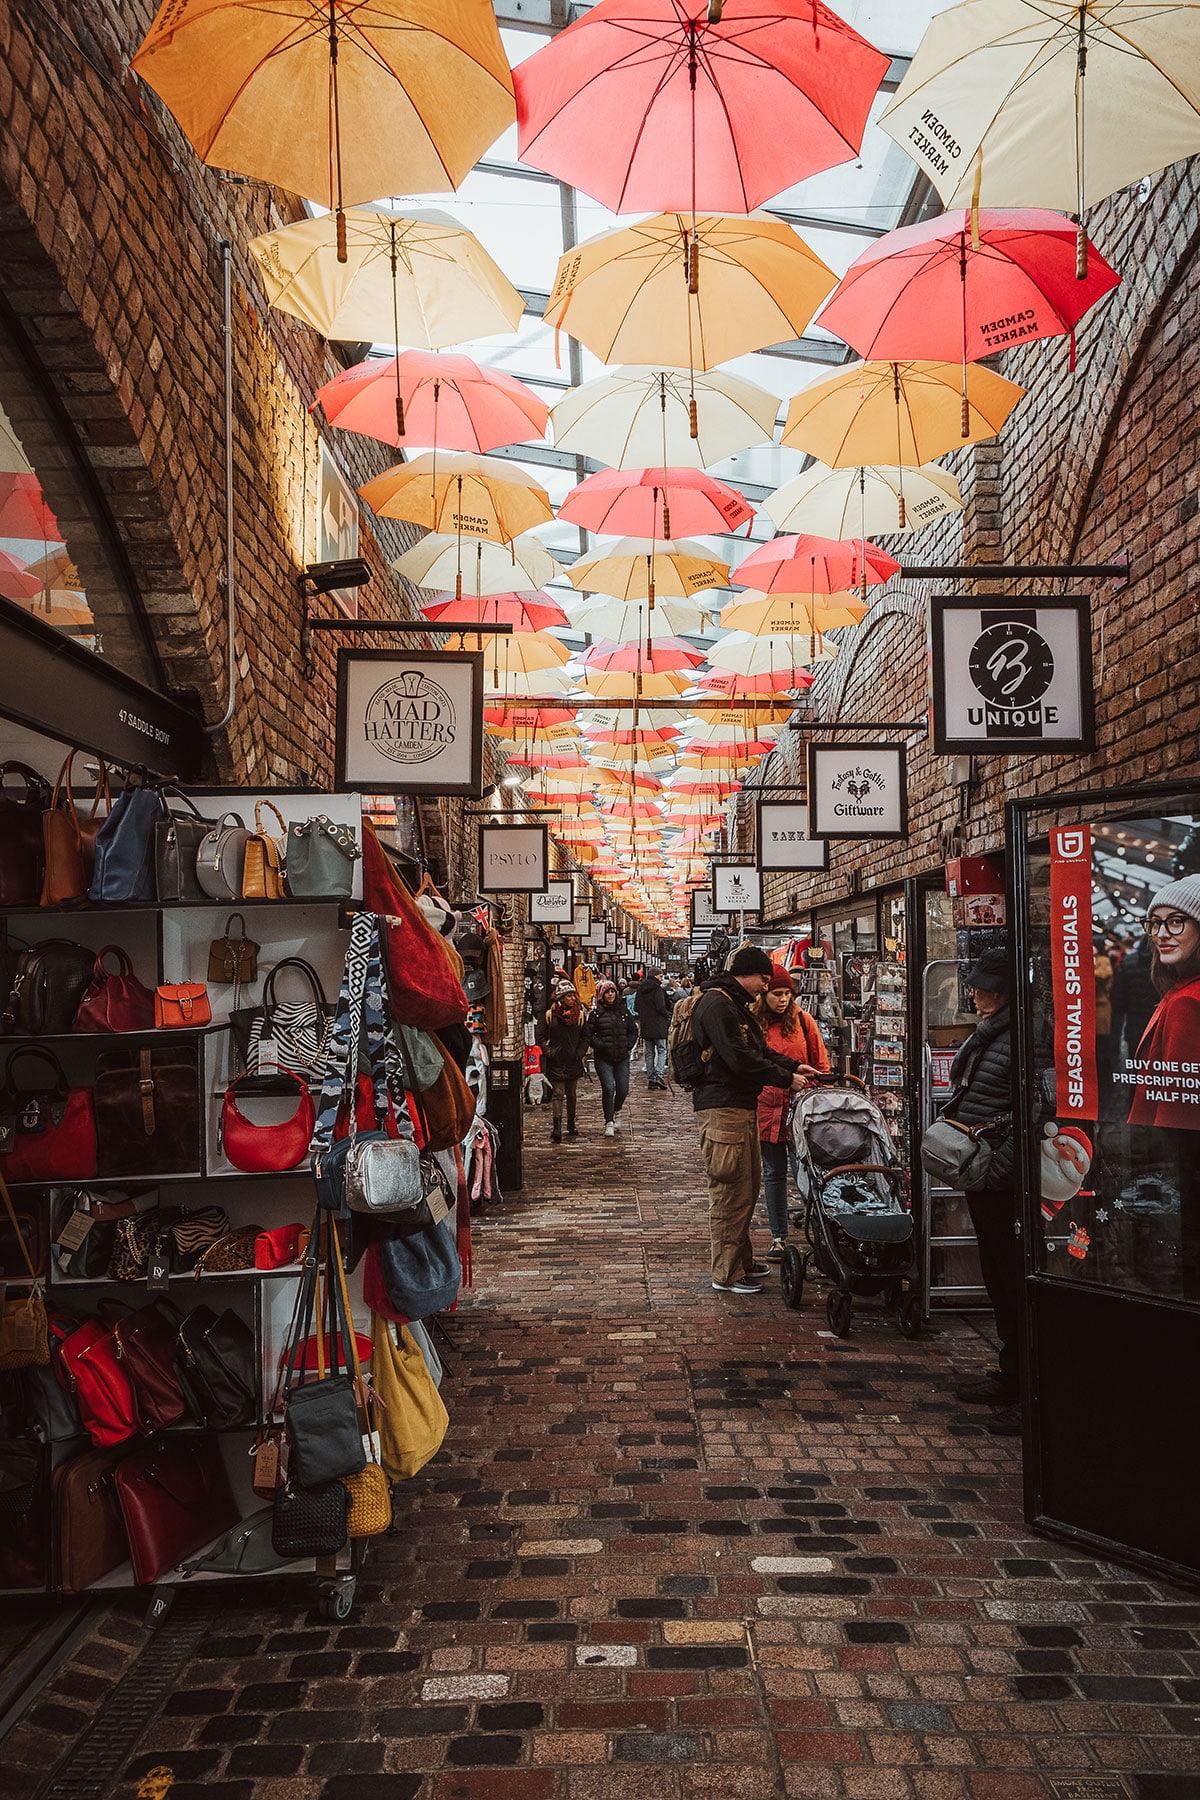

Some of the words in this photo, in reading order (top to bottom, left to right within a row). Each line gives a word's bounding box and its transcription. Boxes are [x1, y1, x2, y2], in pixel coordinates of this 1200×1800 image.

[382, 700, 441, 721] MAD
[967, 706, 1060, 727] UNIQUE
[119, 709, 127, 722] 47
[128, 713, 154, 737] SADDLE
[155, 728, 170, 745] ROW
[363, 721, 456, 744] HATTERS
[394, 741, 423, 749] CAMDEN
[831, 770, 854, 791] Fantasy
[855, 766, 862, 776] &
[863, 769, 886, 791] Gothic
[834, 803, 884, 816] Giftware
[490, 853, 537, 865] PSYLO
[1063, 895, 1082, 995] SPECIALS
[1065, 998, 1084, 1108] SEASONAL
[1125, 1059, 1150, 1070] BUY
[1153, 1061, 1179, 1072] ONE
[1182, 1062, 1200, 1073] GE
[1146, 1090, 1179, 1102] HALF
